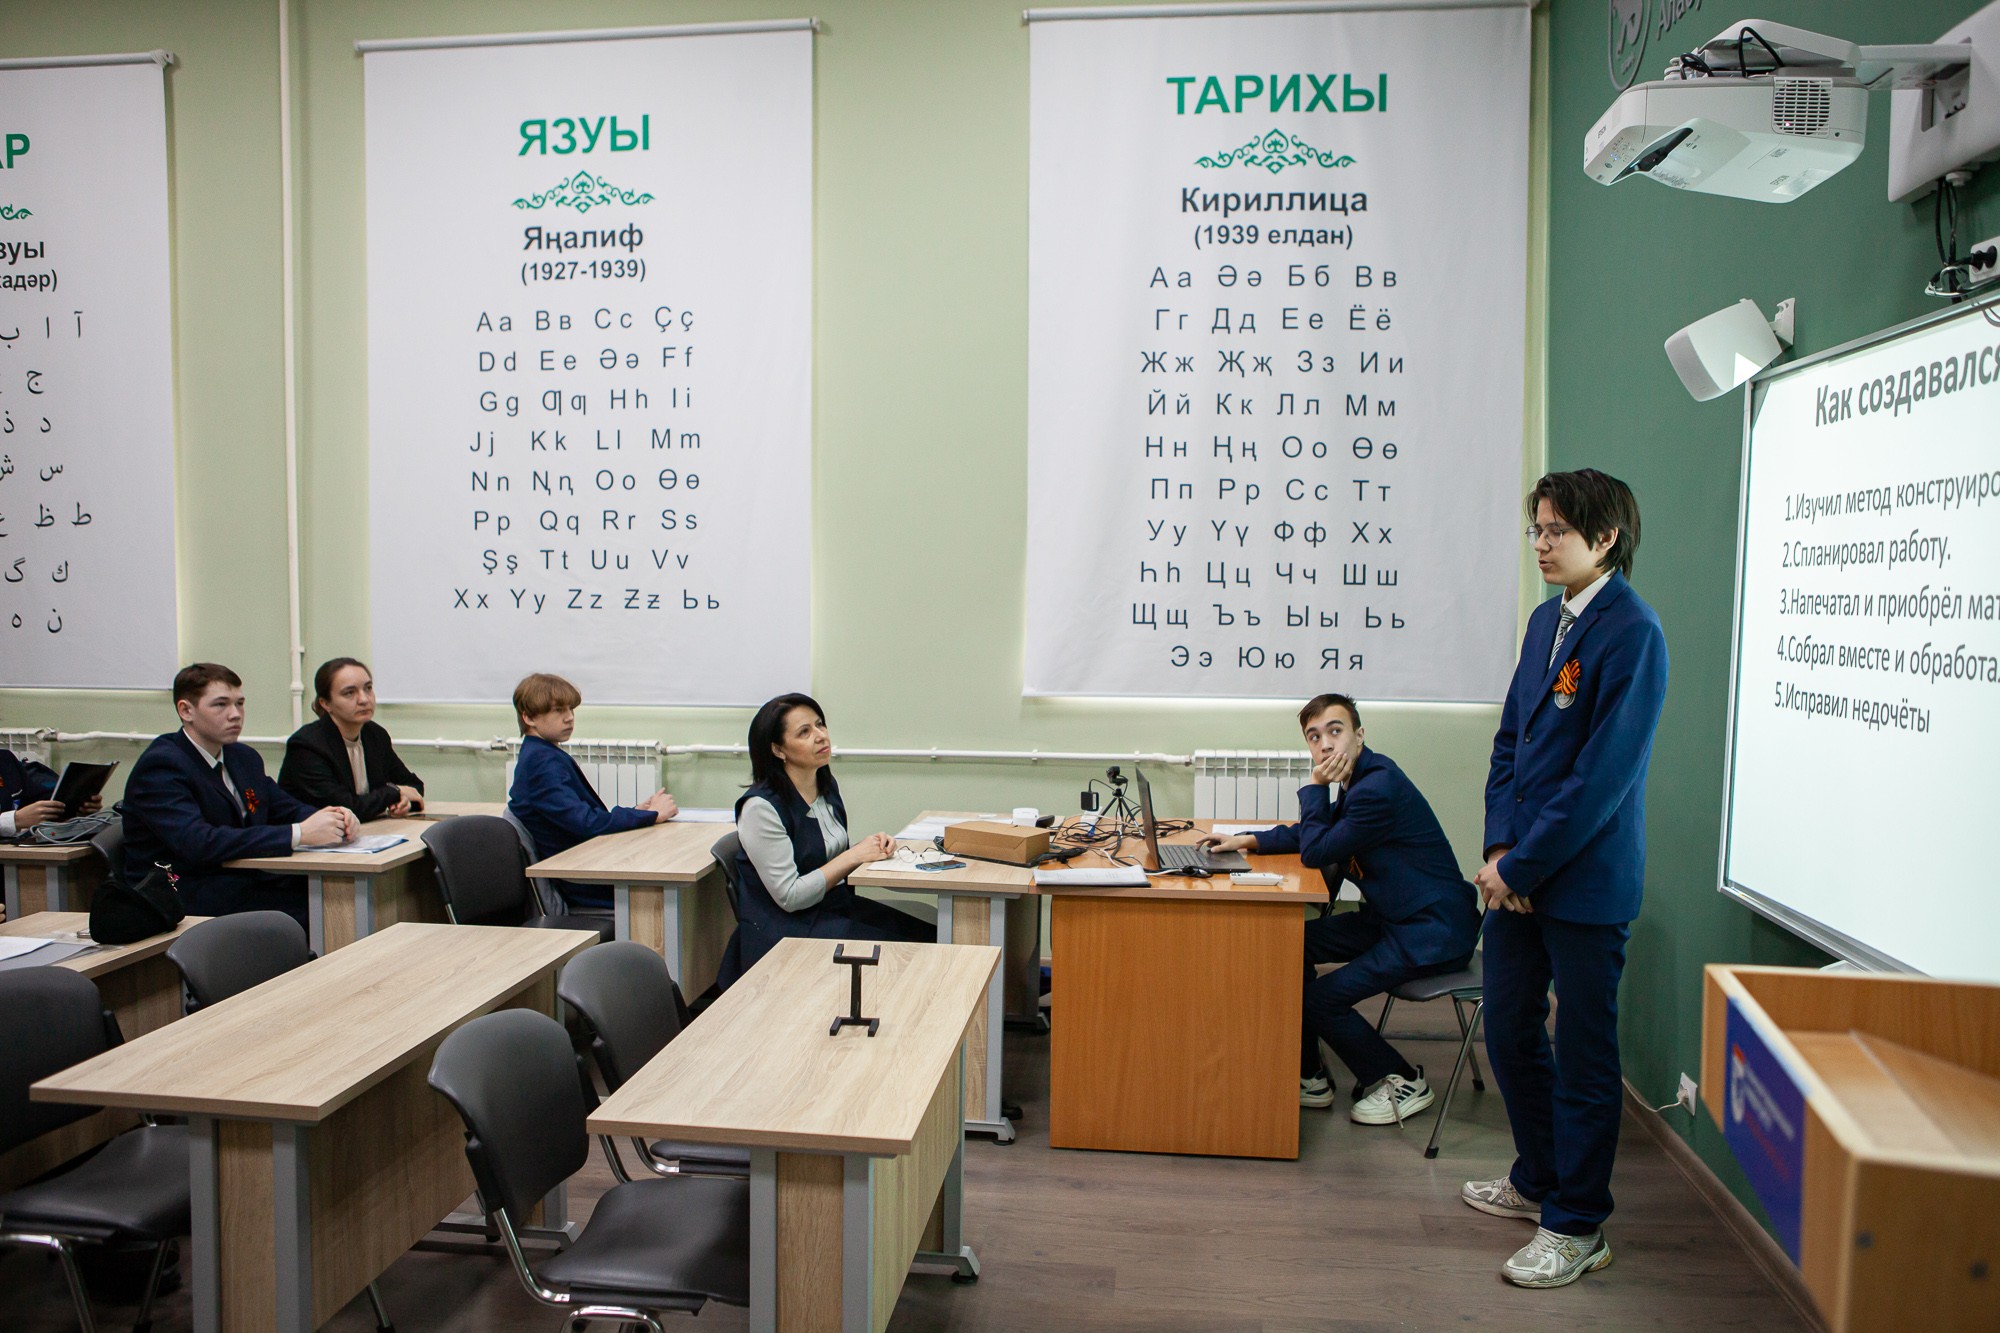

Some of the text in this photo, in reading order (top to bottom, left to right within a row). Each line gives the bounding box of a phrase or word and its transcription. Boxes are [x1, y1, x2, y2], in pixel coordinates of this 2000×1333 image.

[1167, 73, 1387, 114] ТАРИХЫ
[0, 134, 30, 169] Р
[519, 114, 649, 156] ЯЗУЫ
[1183, 187, 1367, 218] Кириллица
[524, 223, 643, 253] Яңалиф
[1195, 225, 1352, 249] (1939 елдан)
[0, 270, 57, 292] адәр)
[522, 259, 645, 285] (1927-1939)
[1816, 385, 1852, 427] Как
[1786, 493, 1841, 524] 1.Изучил
[1846, 487, 1891, 516] метод
[1783, 529, 1950, 572] 2.Спланировал работу.
[1780, 589, 1859, 615] 3.Напечатал
[1865, 595, 1873, 616] и
[1878, 585, 1962, 626] приобрёл
[1778, 635, 2000, 684] 4.Собрал вместе и обработа
[1775, 682, 1929, 733] 5.Исправил недочёты
